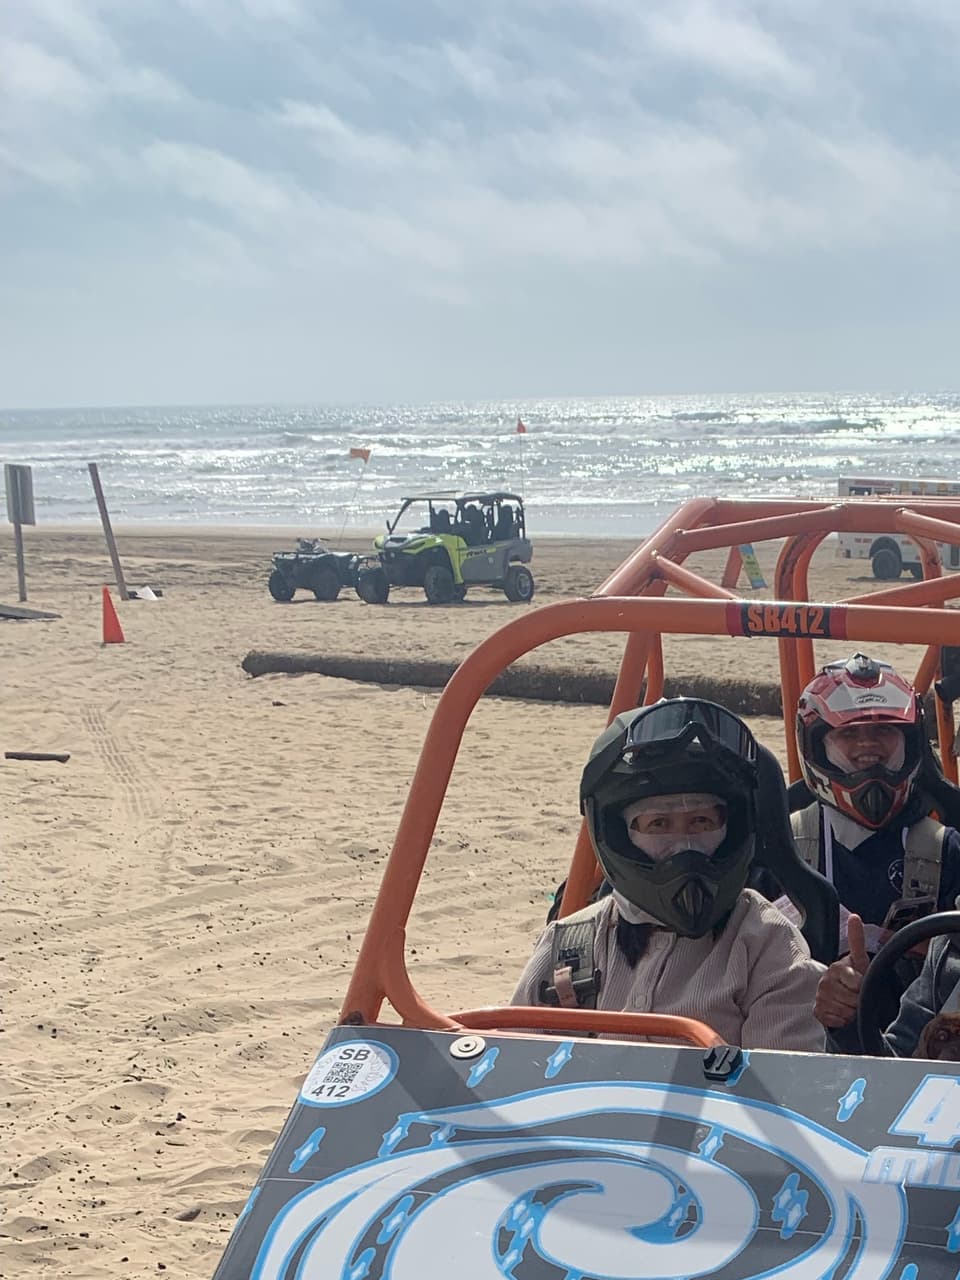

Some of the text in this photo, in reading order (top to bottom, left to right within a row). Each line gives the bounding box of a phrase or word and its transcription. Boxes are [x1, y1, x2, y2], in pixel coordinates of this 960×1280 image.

[747, 604, 825, 635] SB412
[339, 1048, 371, 1061] SB
[311, 1084, 351, 1098] 412
